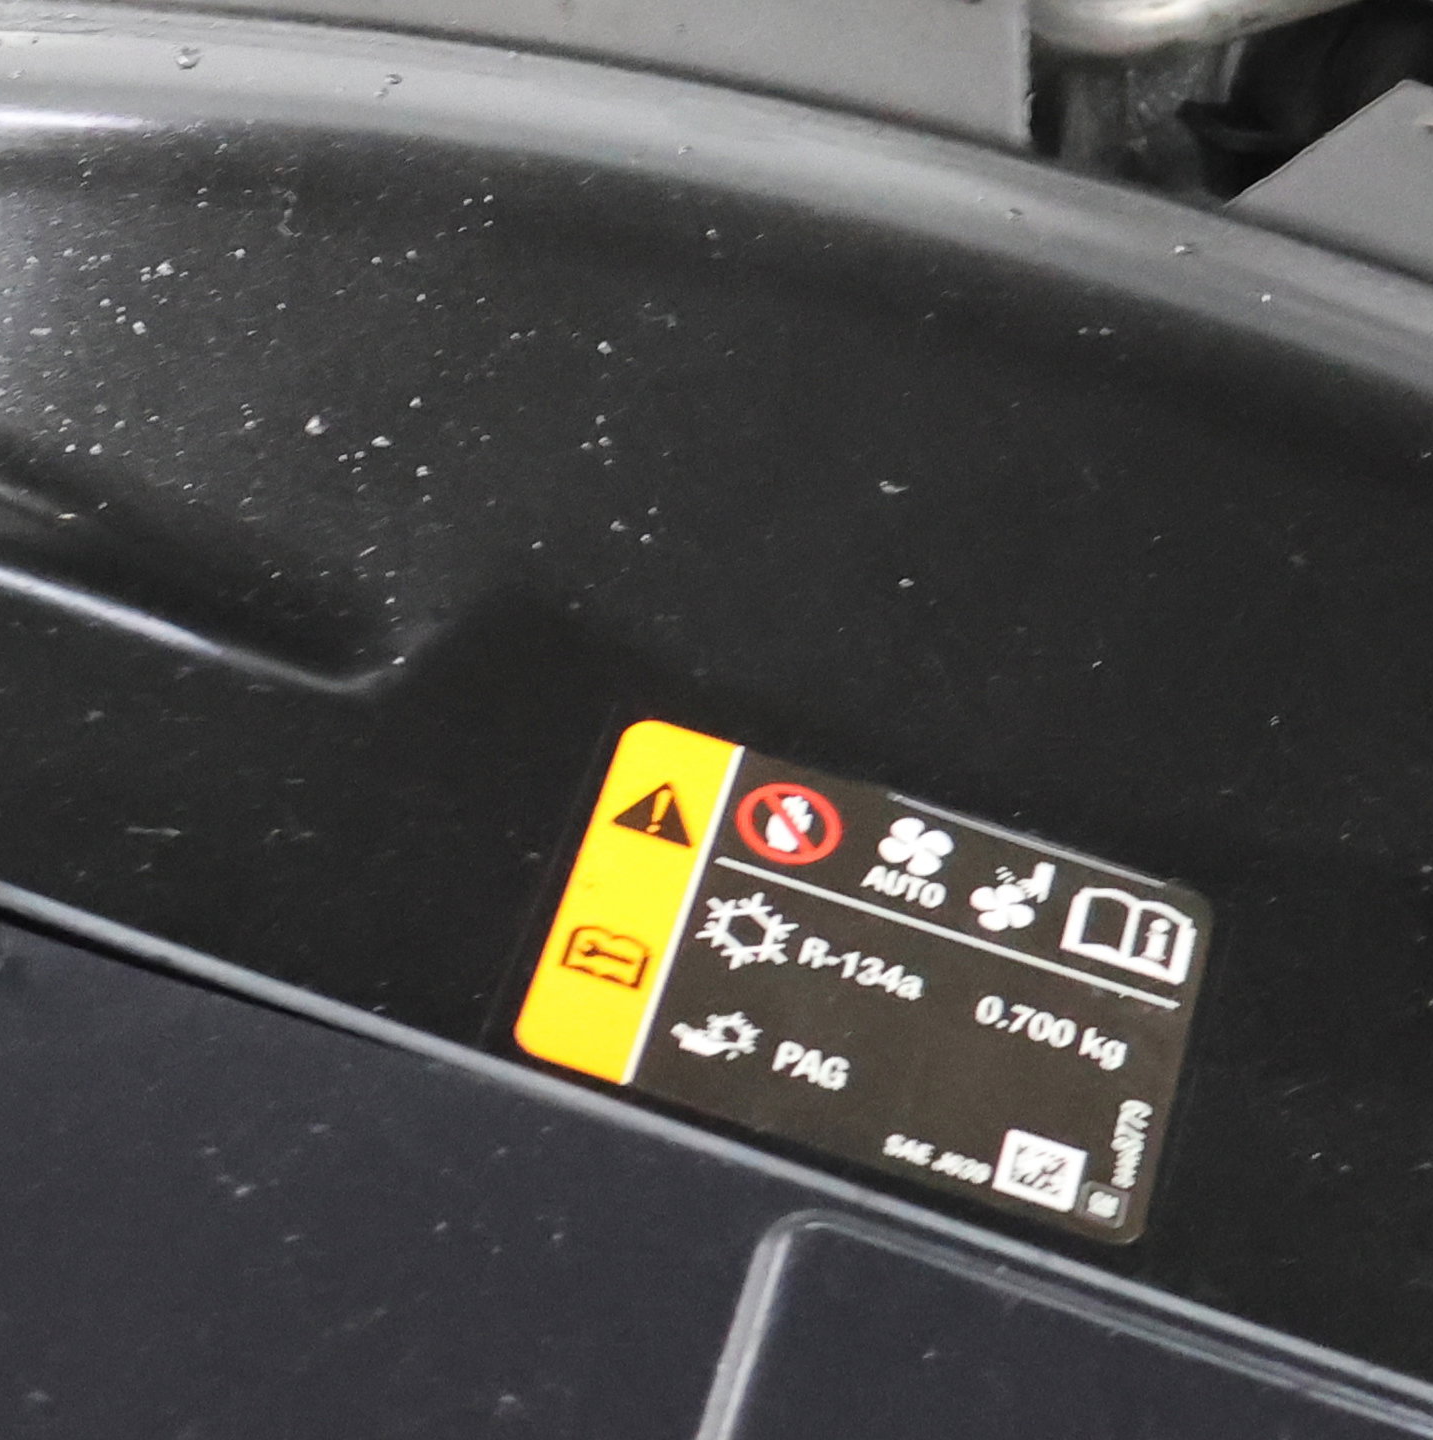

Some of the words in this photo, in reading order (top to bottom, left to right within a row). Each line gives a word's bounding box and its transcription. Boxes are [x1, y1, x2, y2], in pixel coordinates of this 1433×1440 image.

[860, 865, 947, 909] AUTO
[797, 936, 924, 1001] R-134a
[975, 995, 1077, 1048] 0.700
[1078, 1027, 1128, 1071] kg
[771, 1040, 851, 1091] PAG
